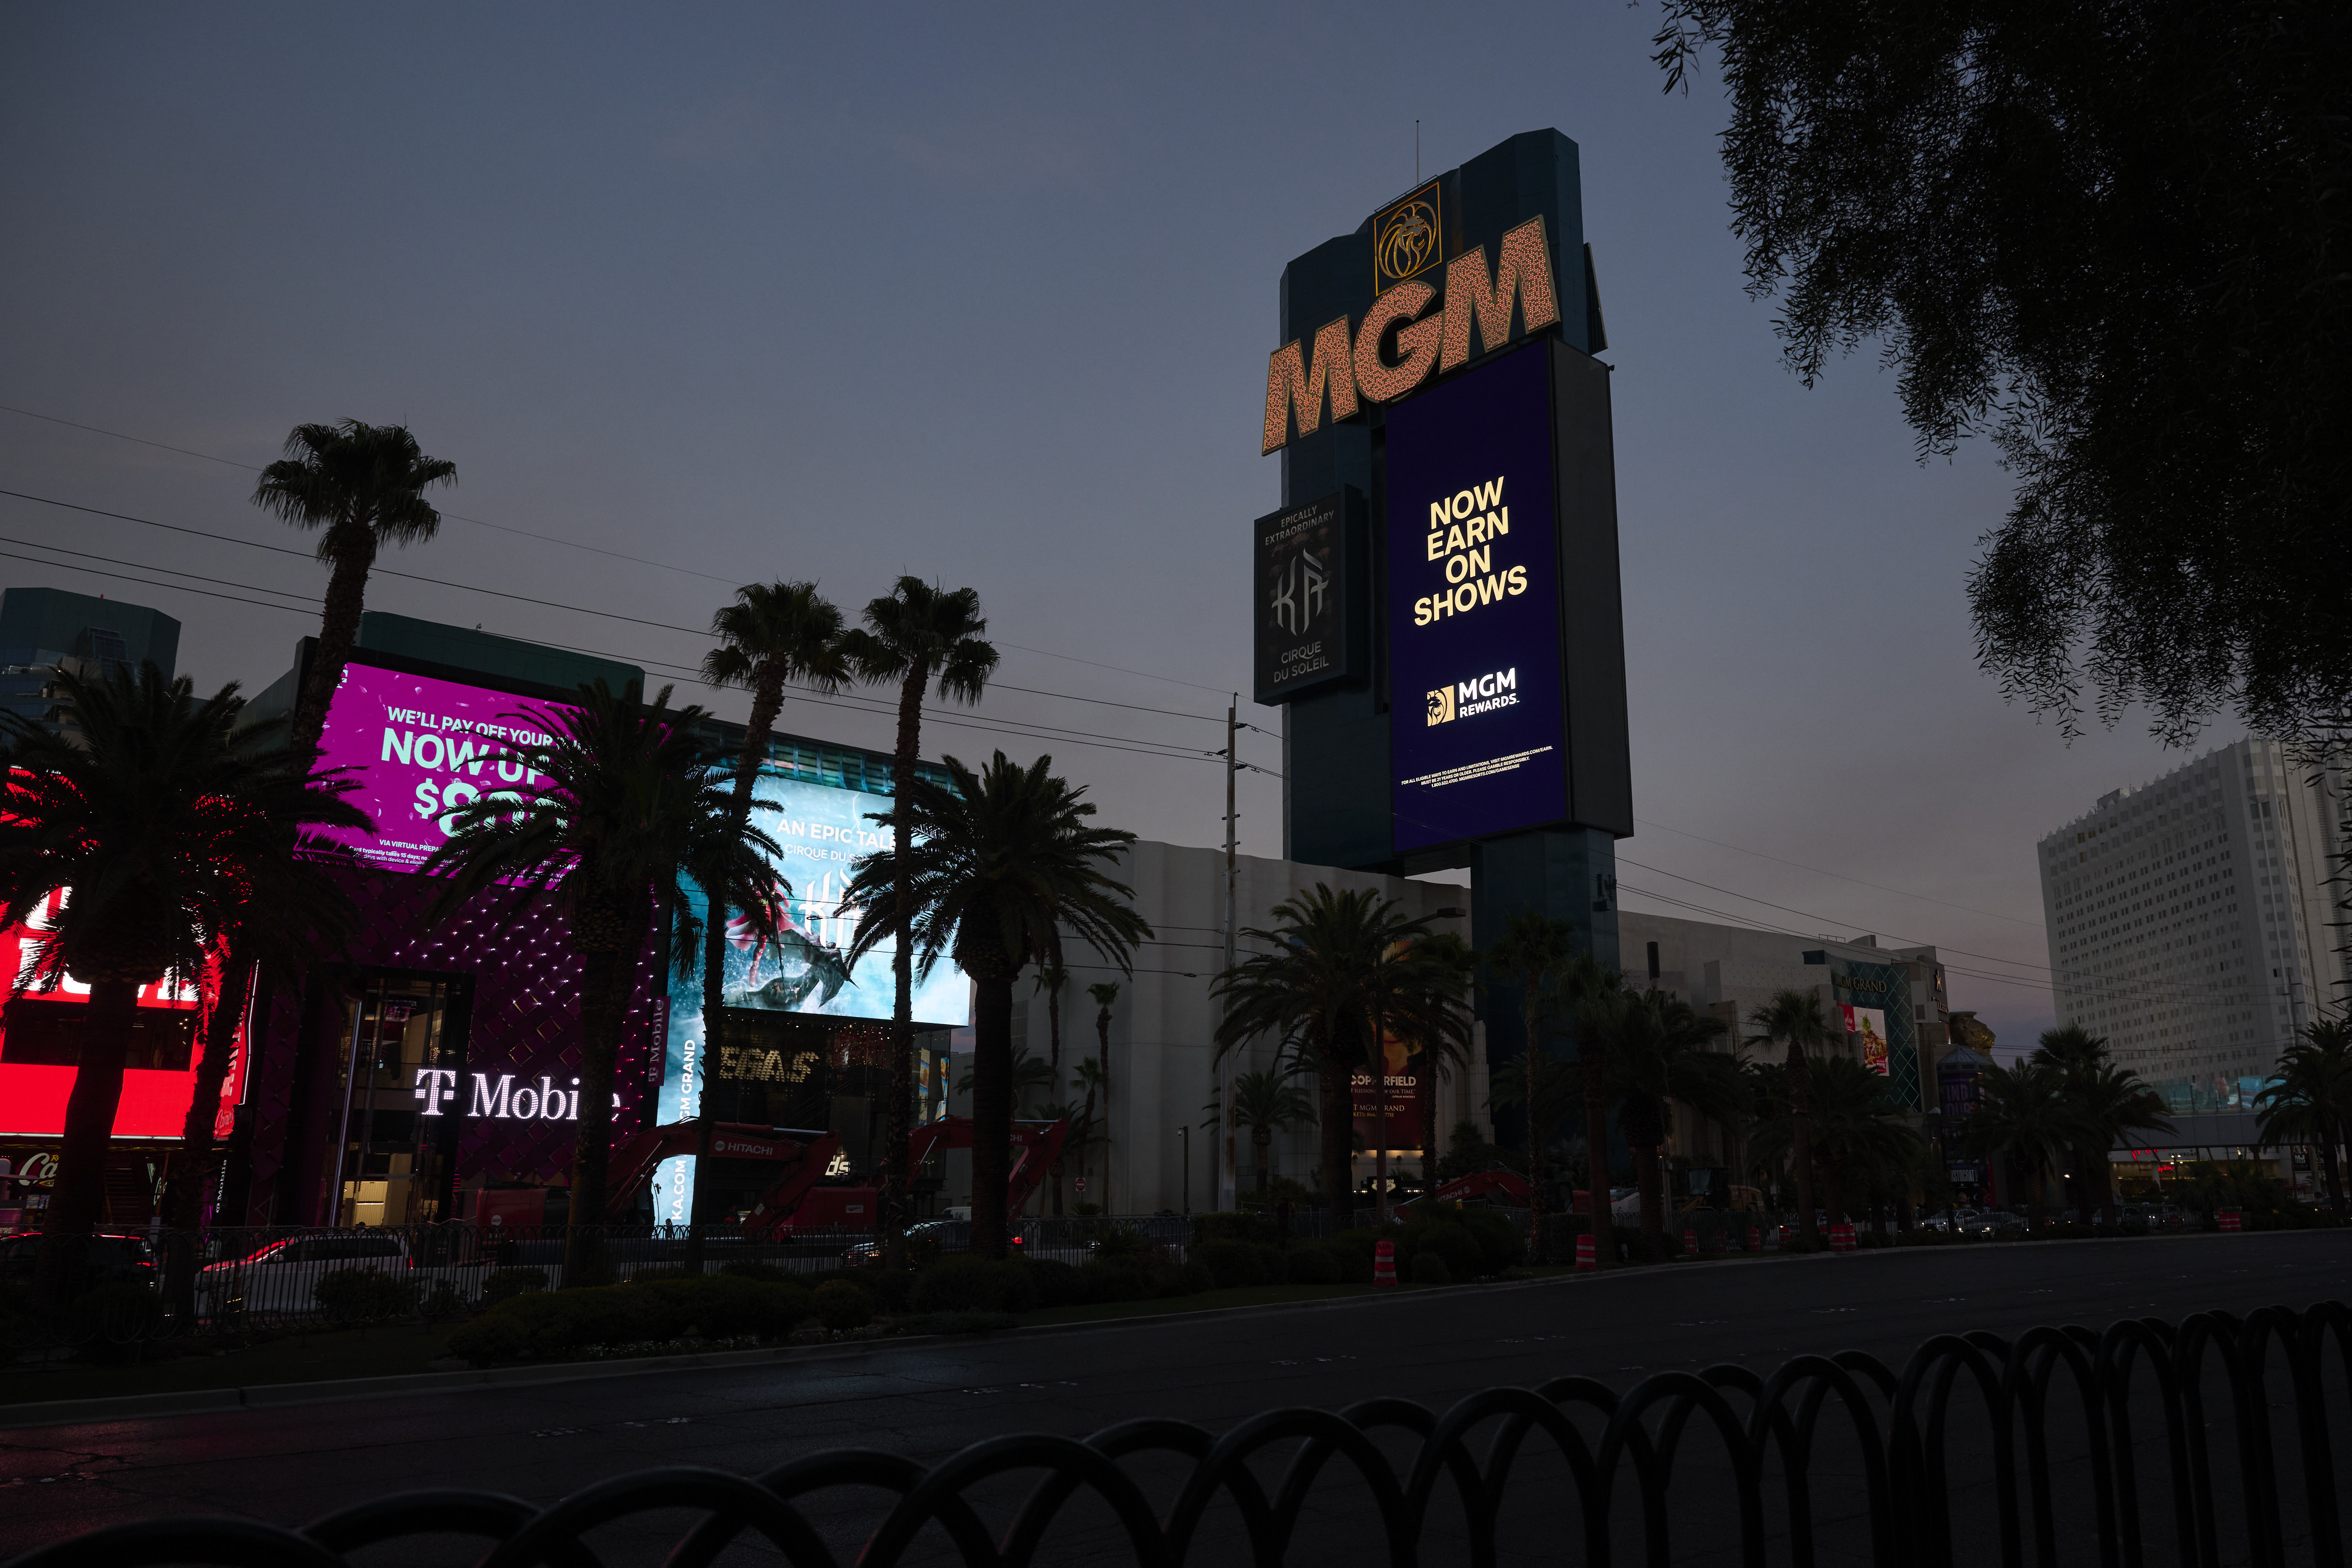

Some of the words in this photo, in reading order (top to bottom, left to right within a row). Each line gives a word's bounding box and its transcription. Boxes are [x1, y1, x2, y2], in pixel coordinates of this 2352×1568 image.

[1262, 214, 1561, 457] MGM
[1281, 504, 1318, 528] EPICALLY
[1430, 476, 1504, 530] NOW
[1265, 510, 1335, 546] EXTRAORDINARY
[1427, 506, 1509, 561] EARN
[1445, 544, 1491, 584] ON
[1414, 565, 1528, 626] SHOWS
[1274, 667, 1289, 683] DU
[1291, 656, 1329, 677] SOLEIL
[1281, 640, 1322, 664] CIRQUE
[1458, 667, 1516, 704] MGM
[387, 706, 439, 730] WE'LL
[441, 716, 475, 733] PAY
[476, 722, 507, 738] OFF
[509, 727, 553, 746] YOUR
[380, 727, 490, 777] NOW
[1466, 760, 1491, 770] LIMITATIONS,
[1501, 745, 1553, 761] MGMREWARDS.COM/EARN.
[1503, 756, 1530, 766] RESPONSIBLY.
[1459, 764, 1520, 781] MGMRESORTS.COM/GAMESENSE
[413, 777, 569, 843] $8
[362, 848, 386, 856] typically
[392, 841, 419, 850] VIRTUAL
[419, 844, 441, 852] PREPA
[776, 818, 806, 837] AN
[810, 823, 853, 844] EPIC
[856, 830, 896, 850] TALE
[784, 844, 828, 861] CIRQUE
[830, 850, 846, 862] DU
[1835, 973, 1852, 988] MGM
[1853, 977, 1887, 993] GRAND
[650, 999, 664, 1059] Mobile
[681, 1039, 696, 1095] GRAND
[719, 1045, 819, 1083] EGAS
[1351, 1074, 1416, 1086] COPRFIELD
[415, 1068, 457, 1116] T
[468, 1072, 621, 1123] Mobi
[679, 1098, 691, 1119] GM
[727, 1142, 773, 1156] HITACHI
[218, 1159, 227, 1201] Mobile
[671, 1160, 687, 1220] KA.COM
